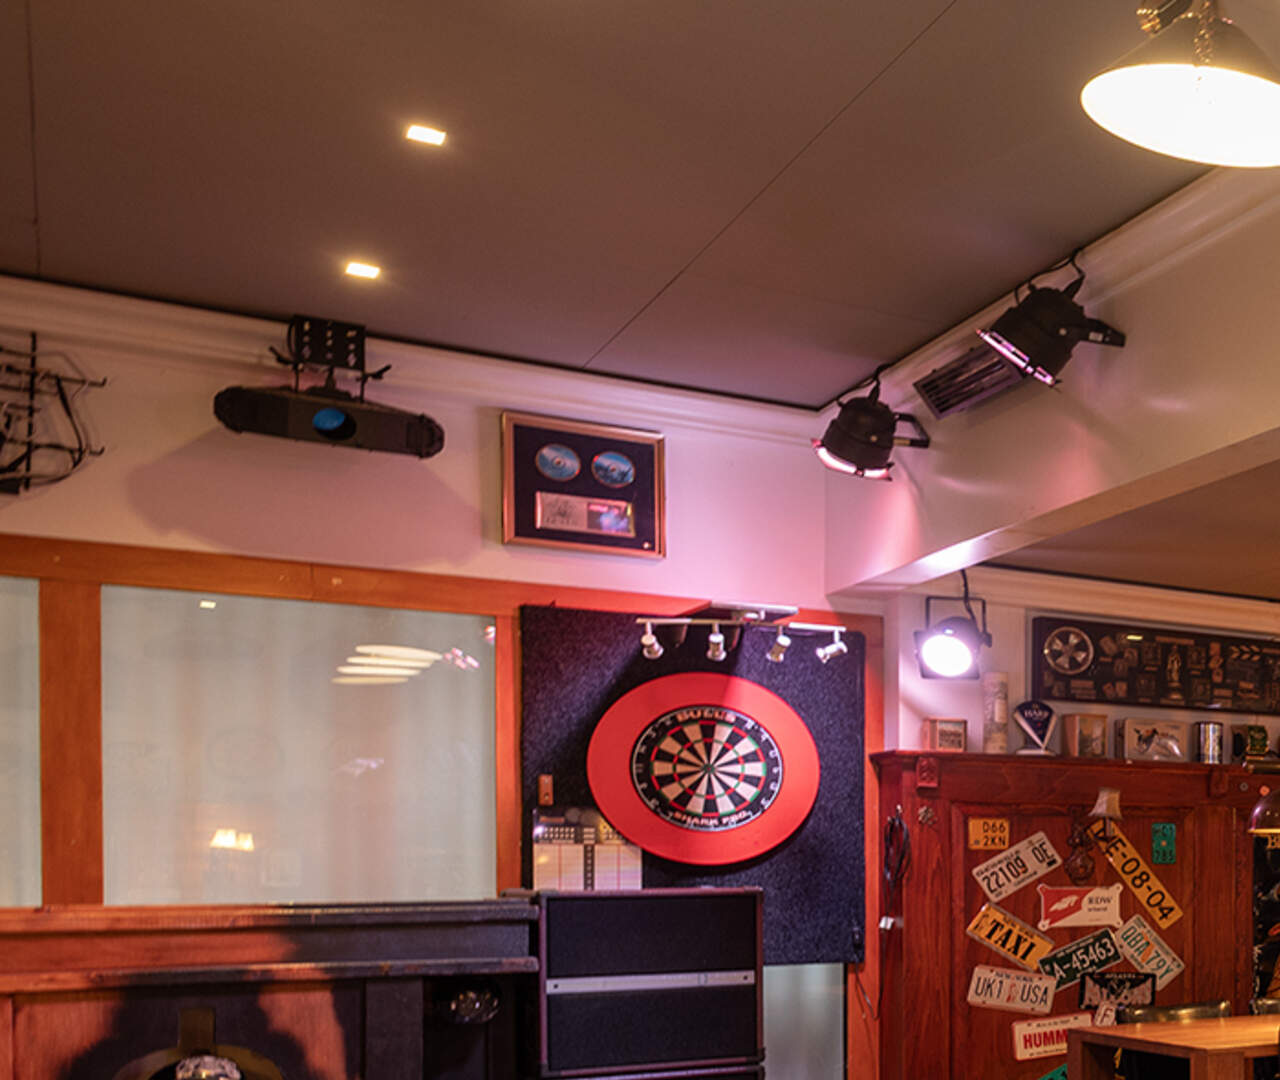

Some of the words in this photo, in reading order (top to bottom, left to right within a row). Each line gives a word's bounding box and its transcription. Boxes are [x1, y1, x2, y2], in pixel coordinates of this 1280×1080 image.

[981, 855, 1029, 894] 22109
[984, 919, 1037, 961] TAXI
[1053, 938, 1115, 980] A-45463
[1020, 982, 1049, 1006] USA
[1022, 1028, 1068, 1050] HUMM
